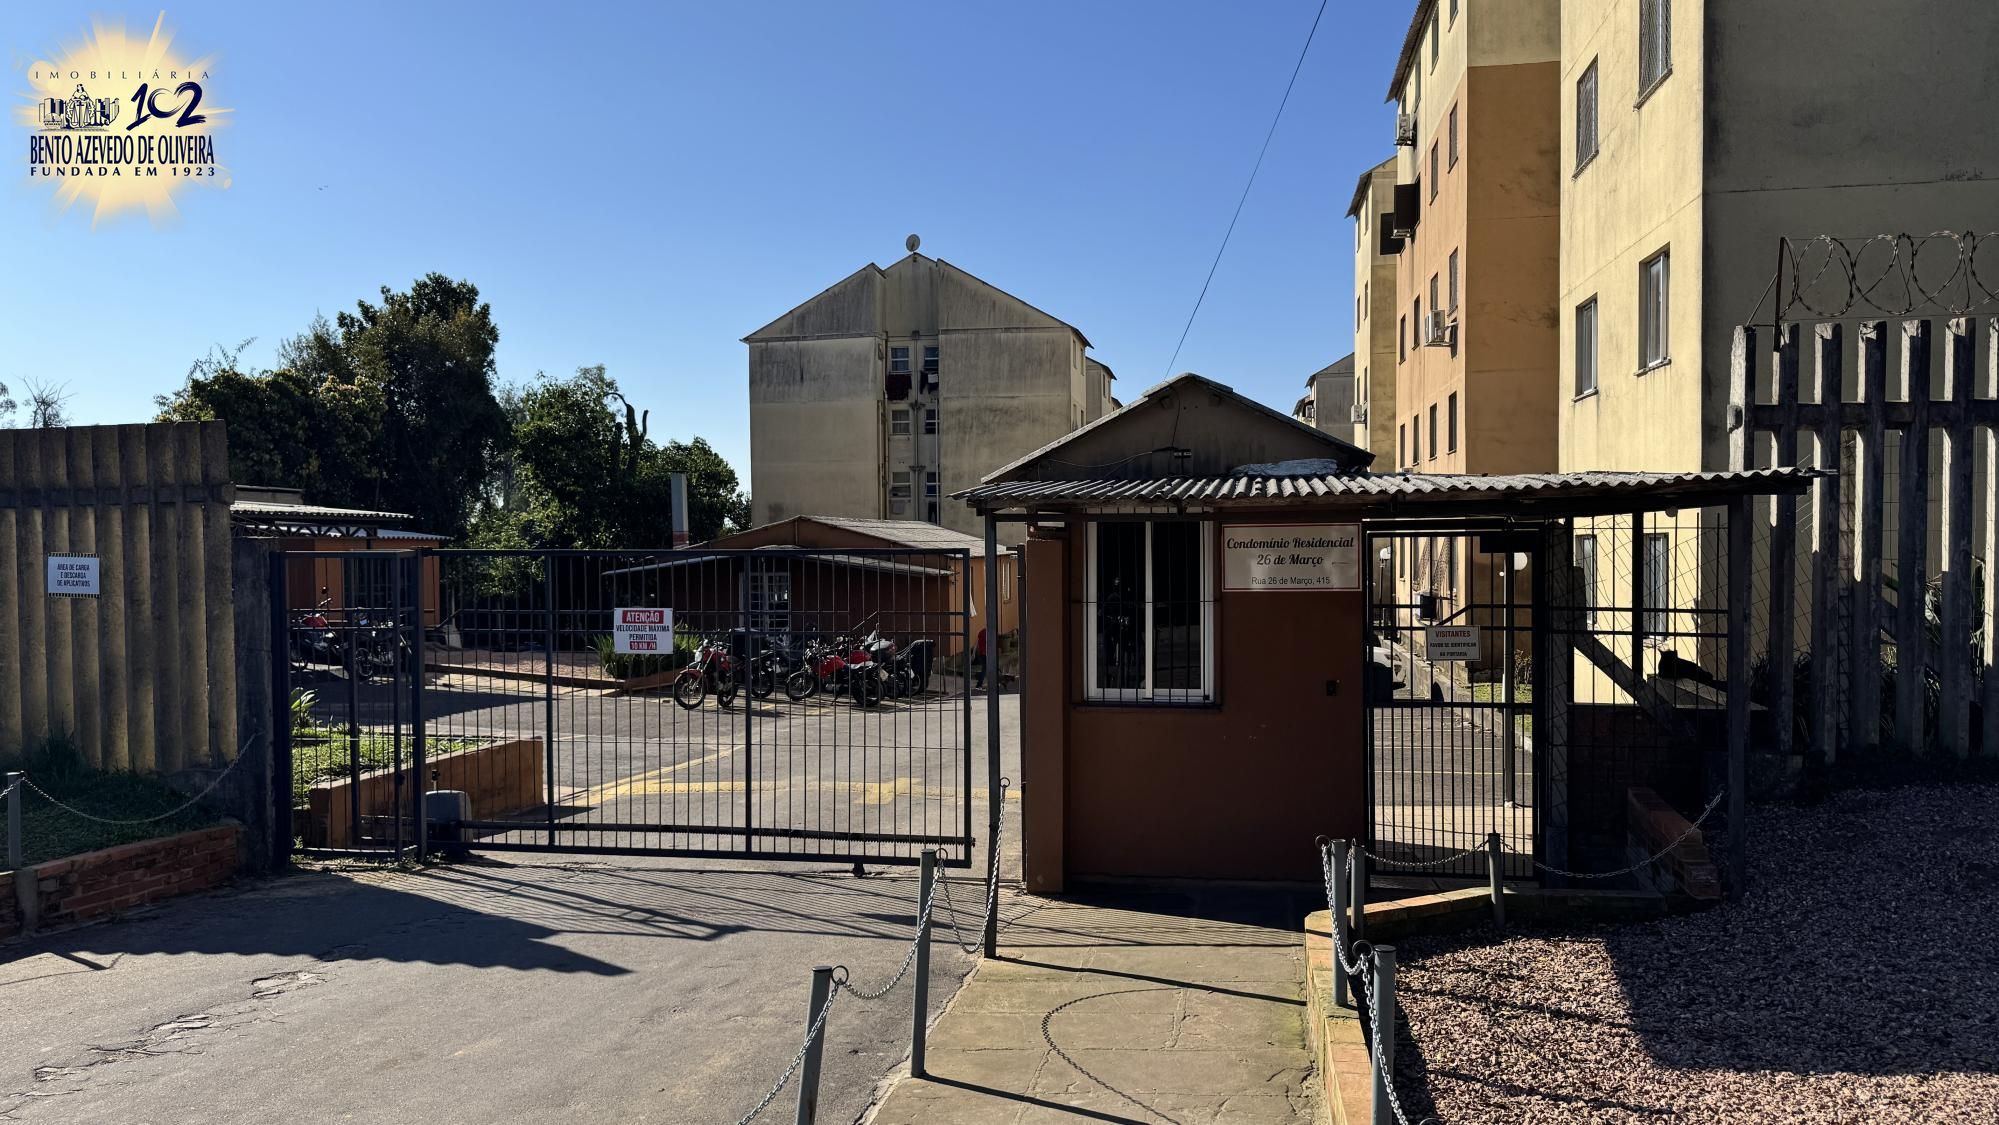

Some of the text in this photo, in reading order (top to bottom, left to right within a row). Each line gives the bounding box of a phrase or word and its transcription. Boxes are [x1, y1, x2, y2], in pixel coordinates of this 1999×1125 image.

[1227, 537, 1354, 549] Condomínio Residencial
[1257, 554, 1323, 567] 26 de Março
[1290, 576, 1315, 586] Março,
[626, 610, 660, 624] ATENÇÃO
[616, 624, 647, 632] VELOCIDADE
[629, 633, 657, 641] PERMITIDA
